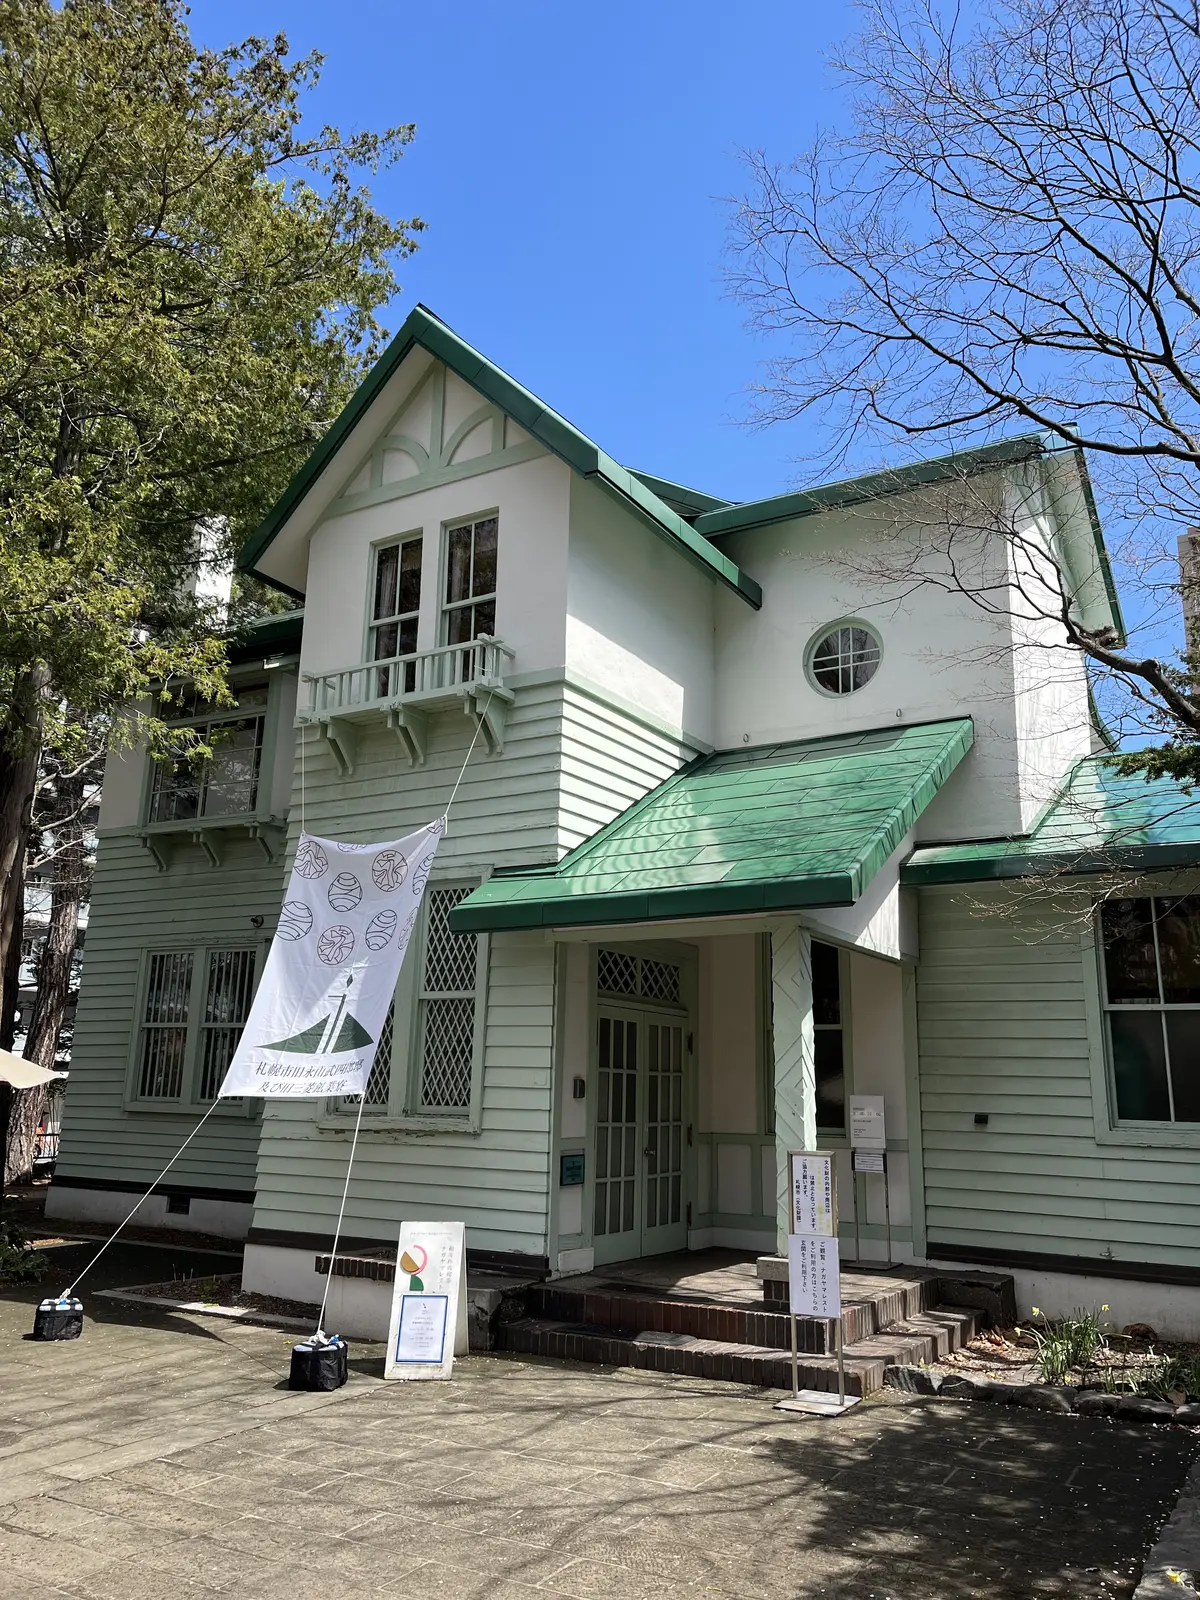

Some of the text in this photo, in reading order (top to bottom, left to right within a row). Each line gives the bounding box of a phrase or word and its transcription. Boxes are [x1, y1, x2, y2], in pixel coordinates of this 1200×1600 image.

[810, 1240, 818, 1311] をご利用の方はこちらの
